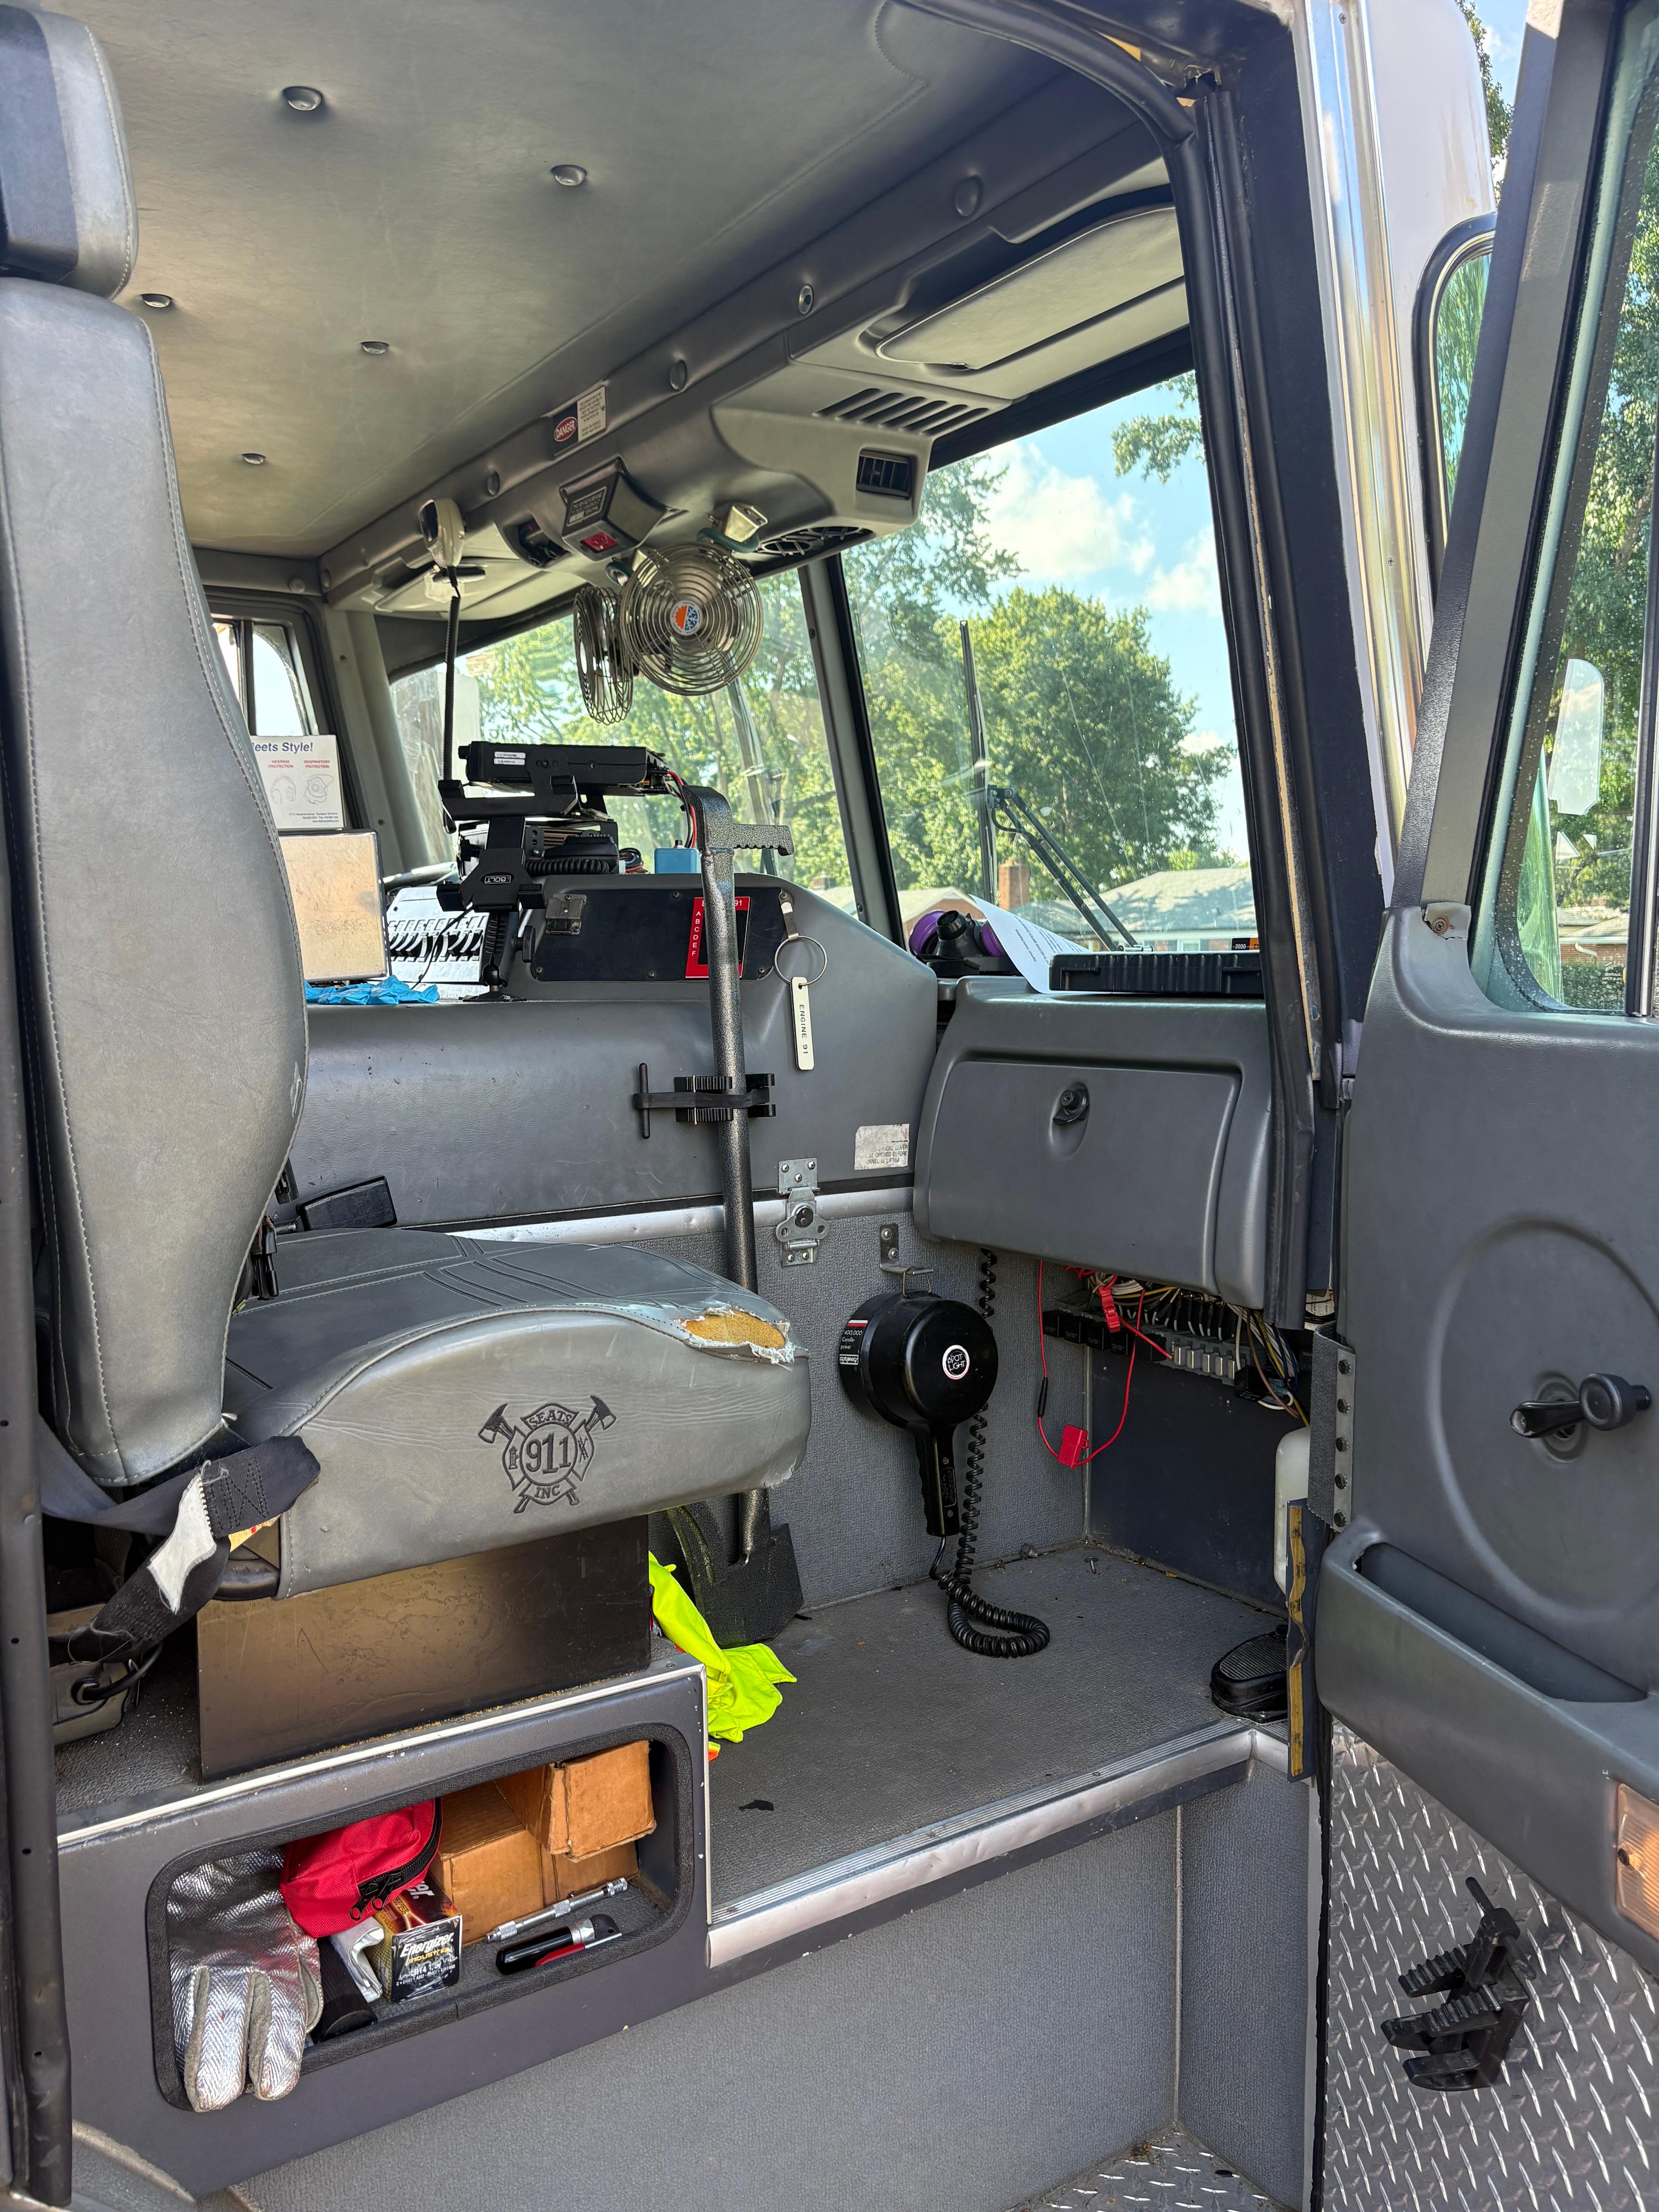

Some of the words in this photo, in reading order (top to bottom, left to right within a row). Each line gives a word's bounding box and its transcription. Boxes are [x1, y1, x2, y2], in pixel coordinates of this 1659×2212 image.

[556, 420, 575, 439] DANGER
[253, 742, 278, 752] eets
[282, 742, 313, 754] Style!
[802, 1044, 808, 1054] 91
[529, 1409, 572, 1428] SEATS
[526, 1433, 571, 1475] 911
[534, 1484, 560, 1499] INC
[400, 1932, 454, 1958] Energizer
